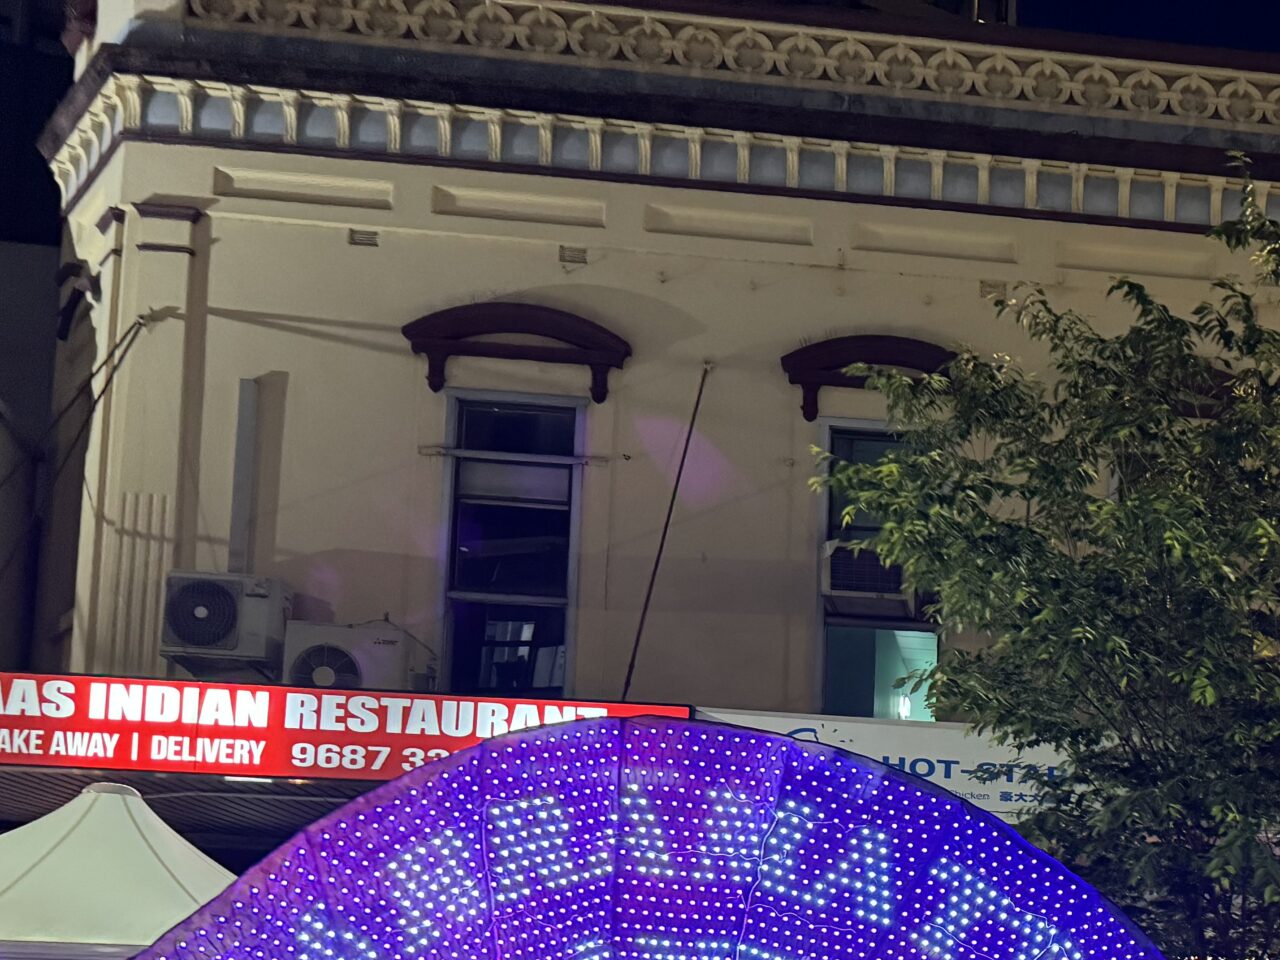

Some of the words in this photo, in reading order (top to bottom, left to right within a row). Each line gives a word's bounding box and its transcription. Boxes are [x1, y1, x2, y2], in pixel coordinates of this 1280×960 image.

[0, 679, 76, 719] AS
[88, 682, 270, 728] INDIAN
[49, 730, 121, 758] AWAY
[151, 734, 266, 765] DELIVERY
[291, 743, 391, 771] 9687
